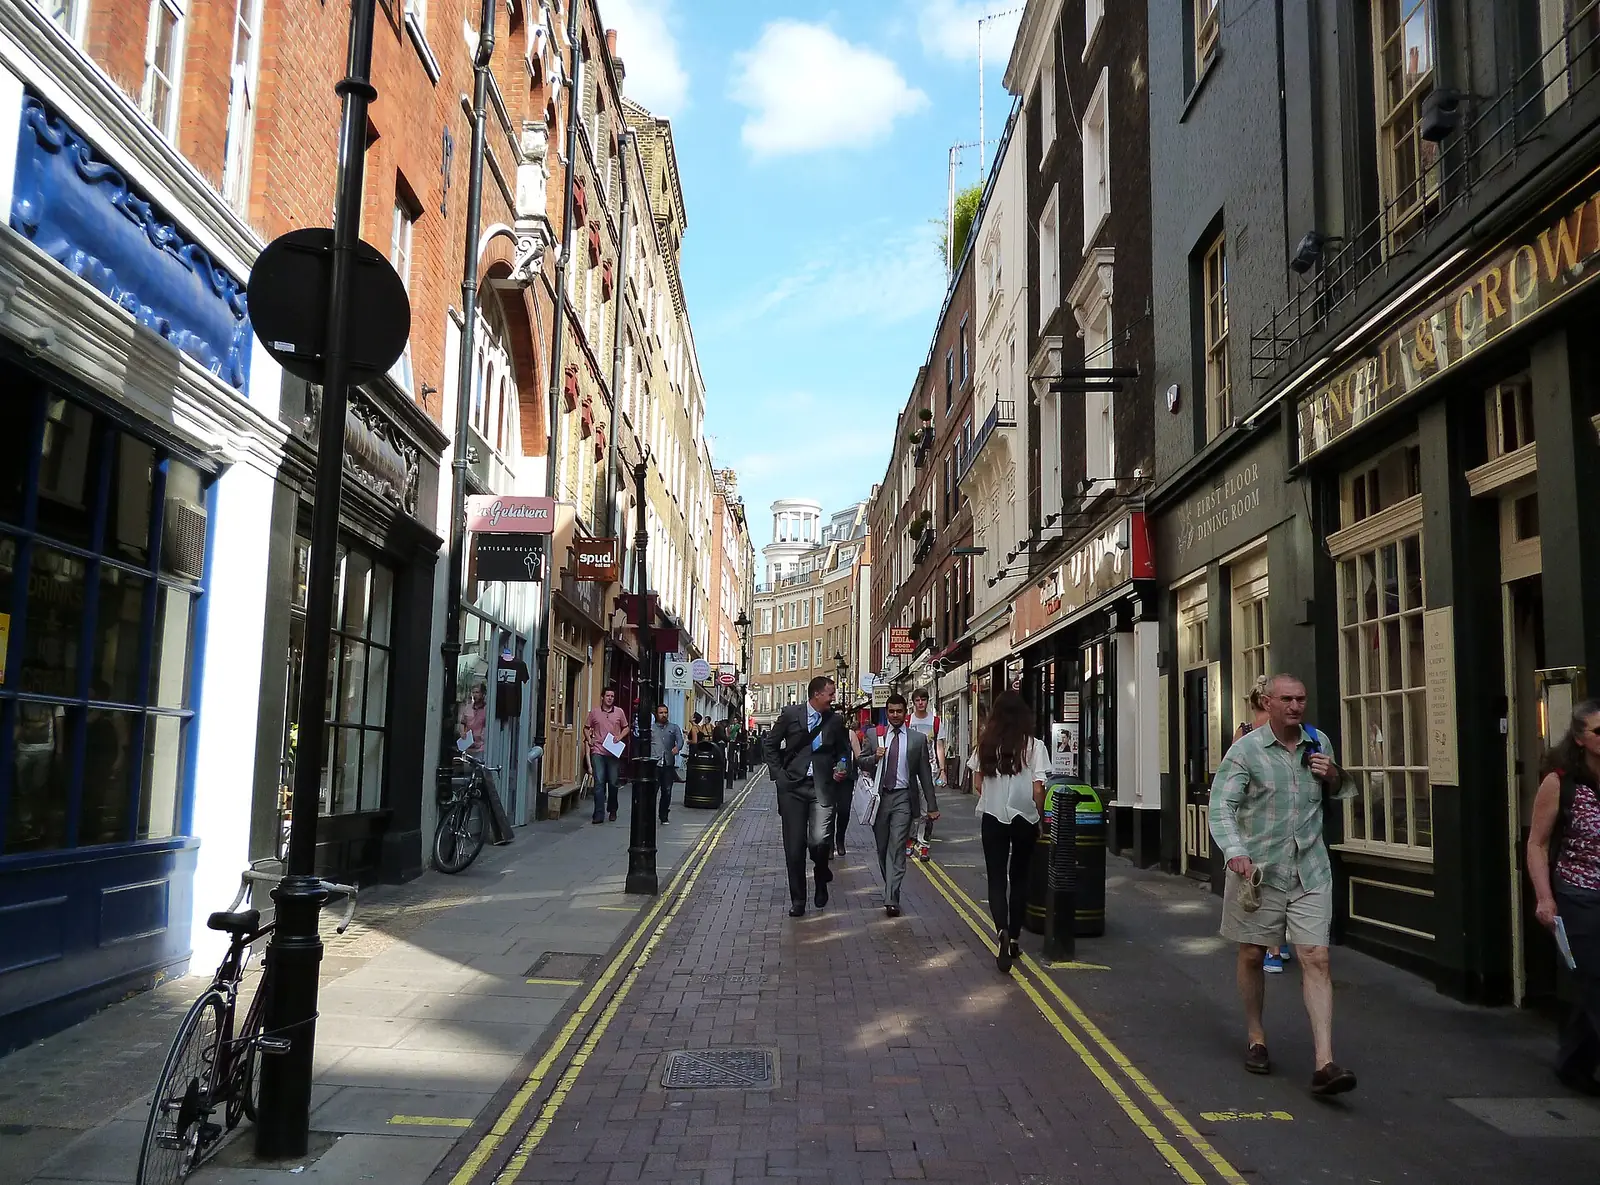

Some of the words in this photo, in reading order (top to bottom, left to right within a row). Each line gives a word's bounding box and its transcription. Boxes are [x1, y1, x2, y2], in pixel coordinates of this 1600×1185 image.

[1412, 318, 1437, 371] &
[489, 500, 548, 526] Gelatiera
[1197, 488, 1221, 518] FIRST
[1225, 463, 1259, 499] FLOOR
[1198, 508, 1229, 541] DINING
[1231, 488, 1260, 521] ROOM
